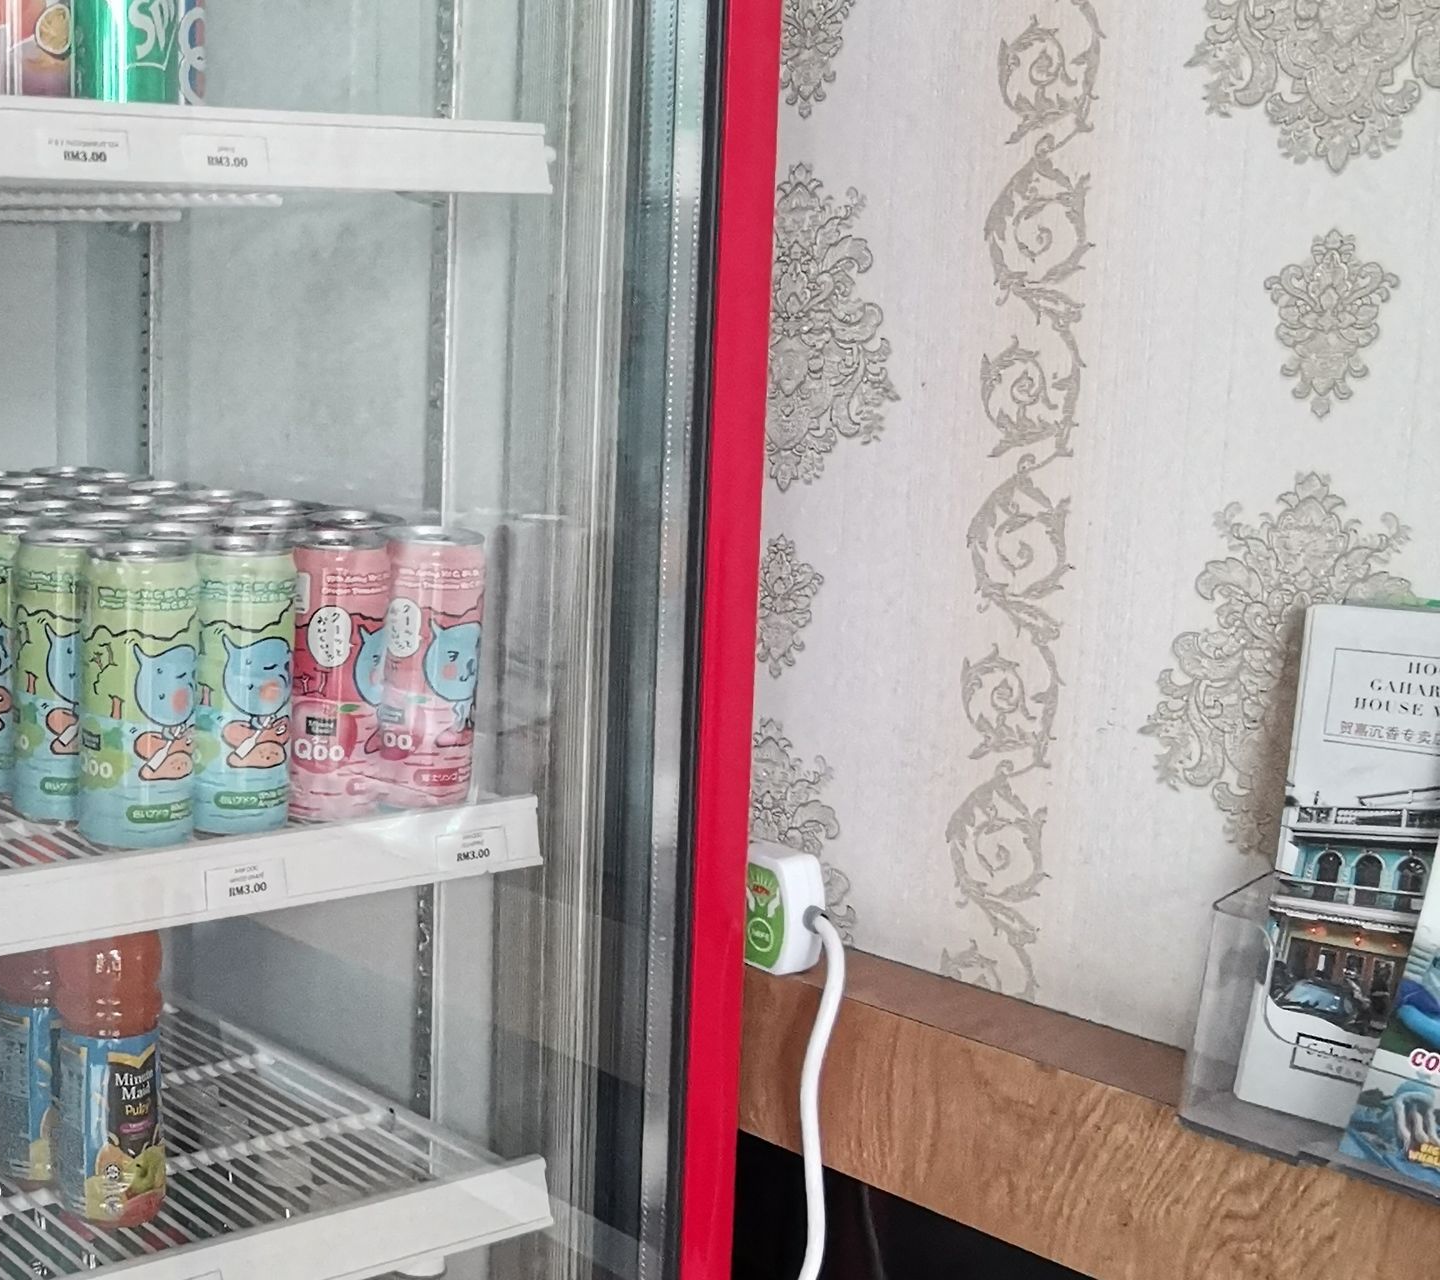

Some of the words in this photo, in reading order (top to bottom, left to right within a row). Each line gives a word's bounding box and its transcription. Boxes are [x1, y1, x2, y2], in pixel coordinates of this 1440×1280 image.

[63, 150, 107, 163] RM3.00
[207, 155, 248, 168] RM3.00
[1408, 661, 1440, 677] HO
[1354, 696, 1423, 717] HOUSE
[456, 847, 490, 862] RM3.00
[228, 881, 267, 898] RM3.00
[114, 1069, 154, 1088] Minute
[121, 1085, 152, 1101] Maid
